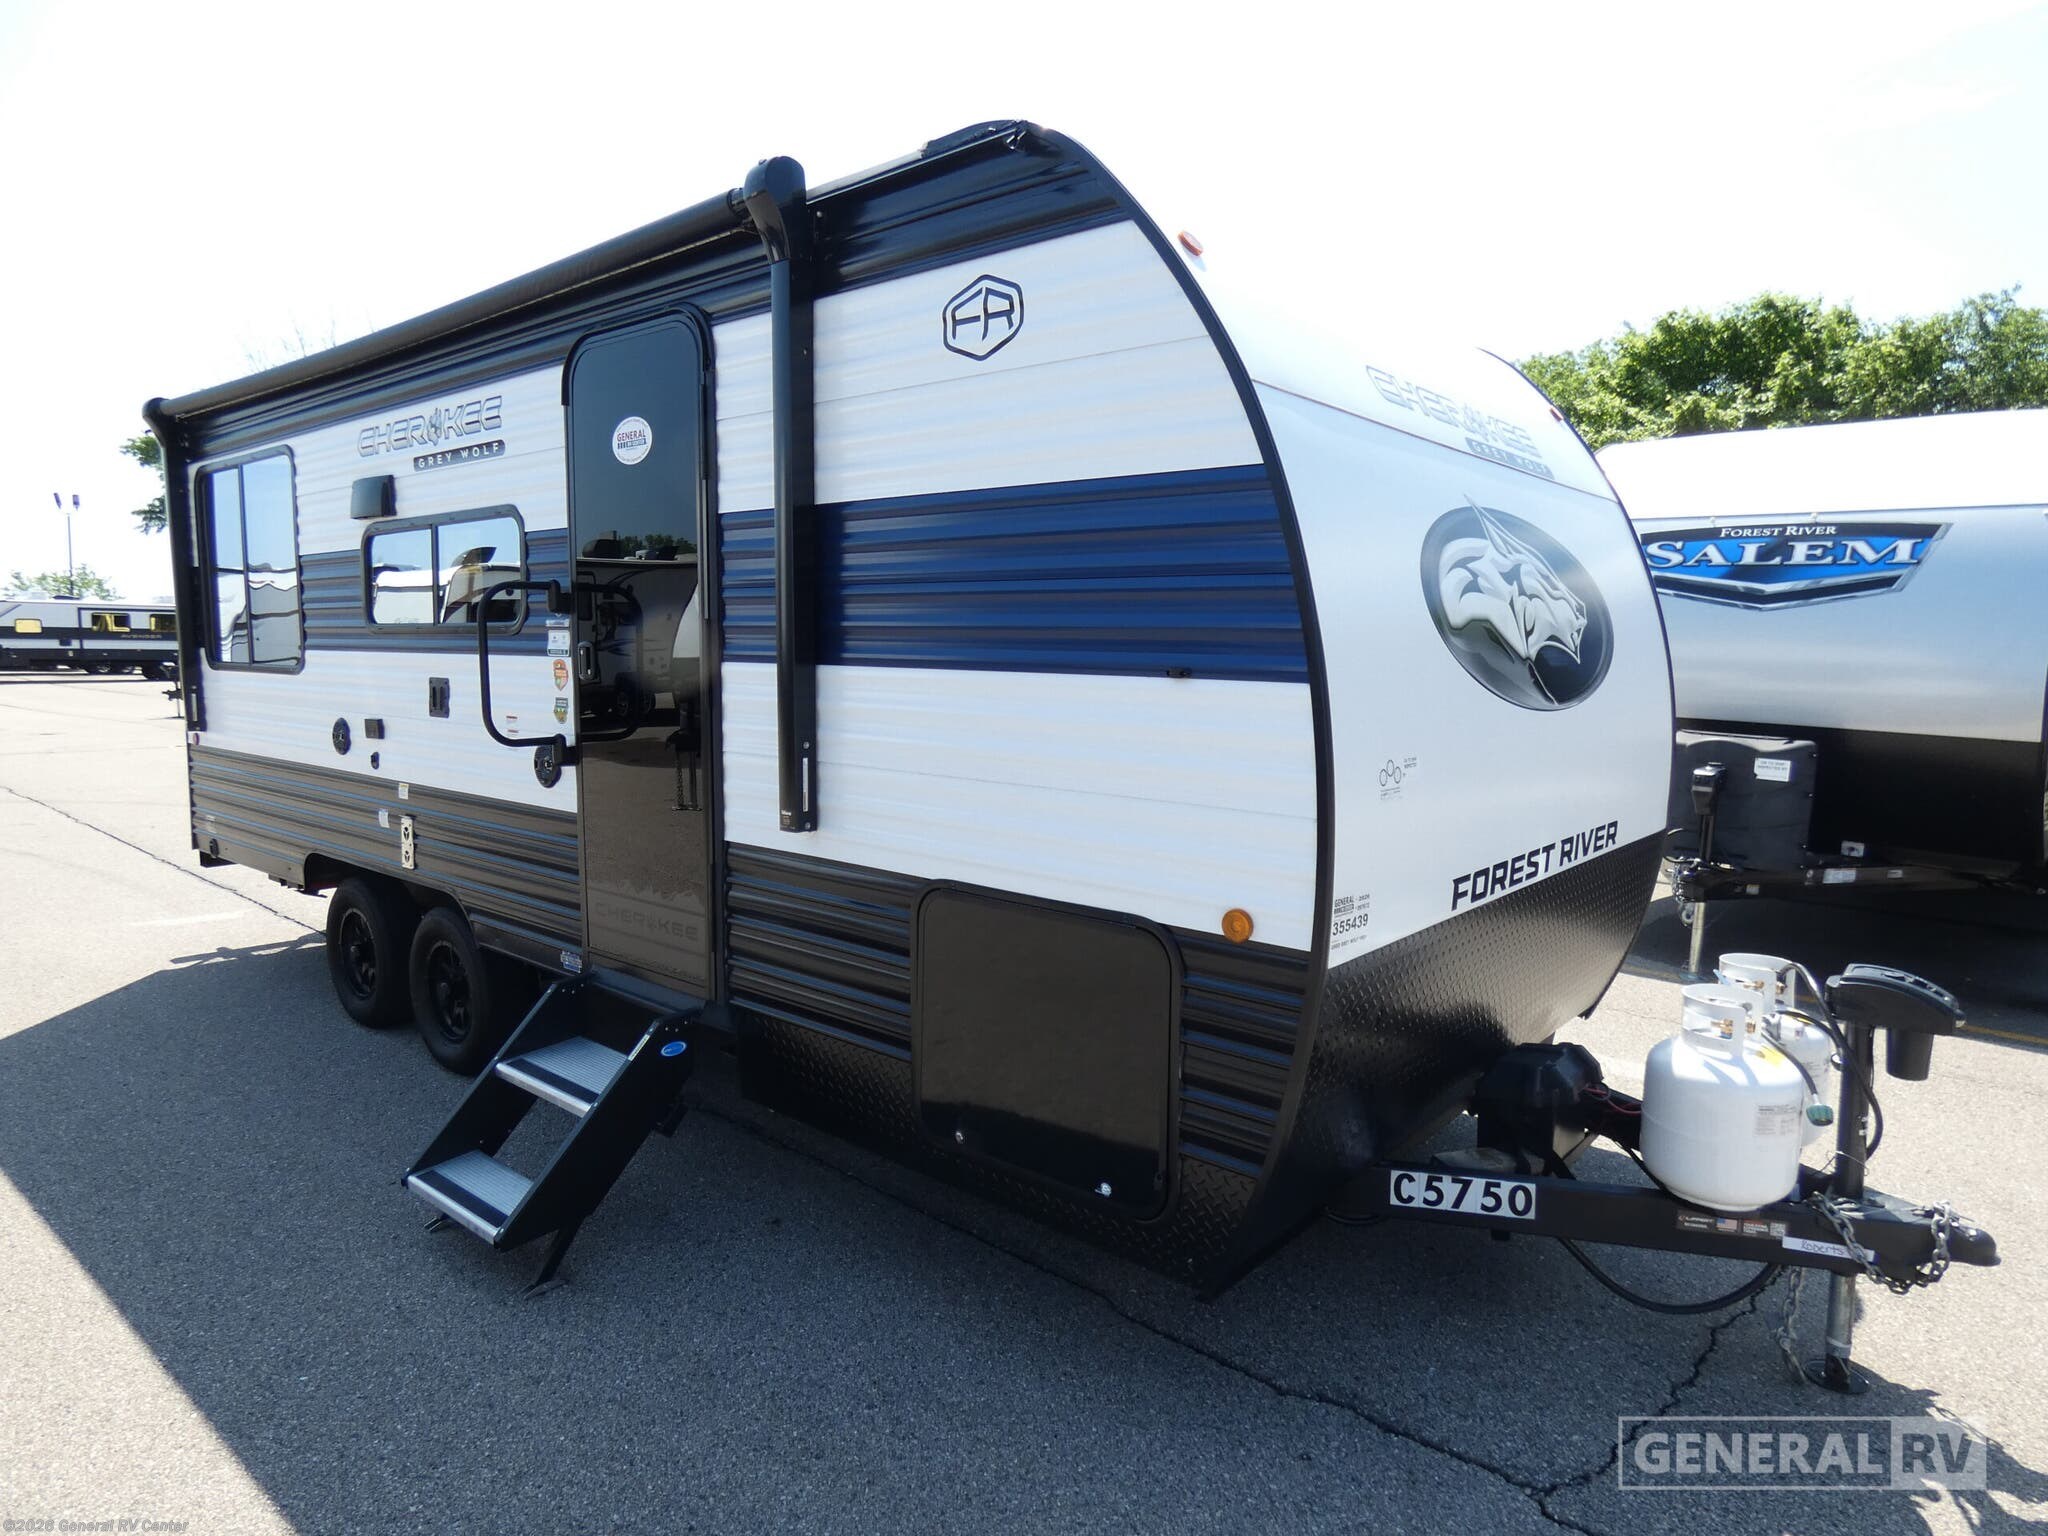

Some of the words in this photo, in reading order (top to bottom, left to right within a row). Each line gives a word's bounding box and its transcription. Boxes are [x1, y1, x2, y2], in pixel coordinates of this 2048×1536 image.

[616, 429, 646, 442] GENERAL
[418, 453, 452, 468] GREY
[460, 442, 499, 458] WOLF
[1720, 527, 1782, 538] FOREST
[1785, 525, 1838, 536] RIVER
[1645, 538, 1924, 568] SALEM
[1451, 843, 1556, 912] FOREST
[1559, 820, 1619, 867] RIVER
[1332, 913, 1369, 936] 355439
[1393, 1172, 1533, 1217] C5750
